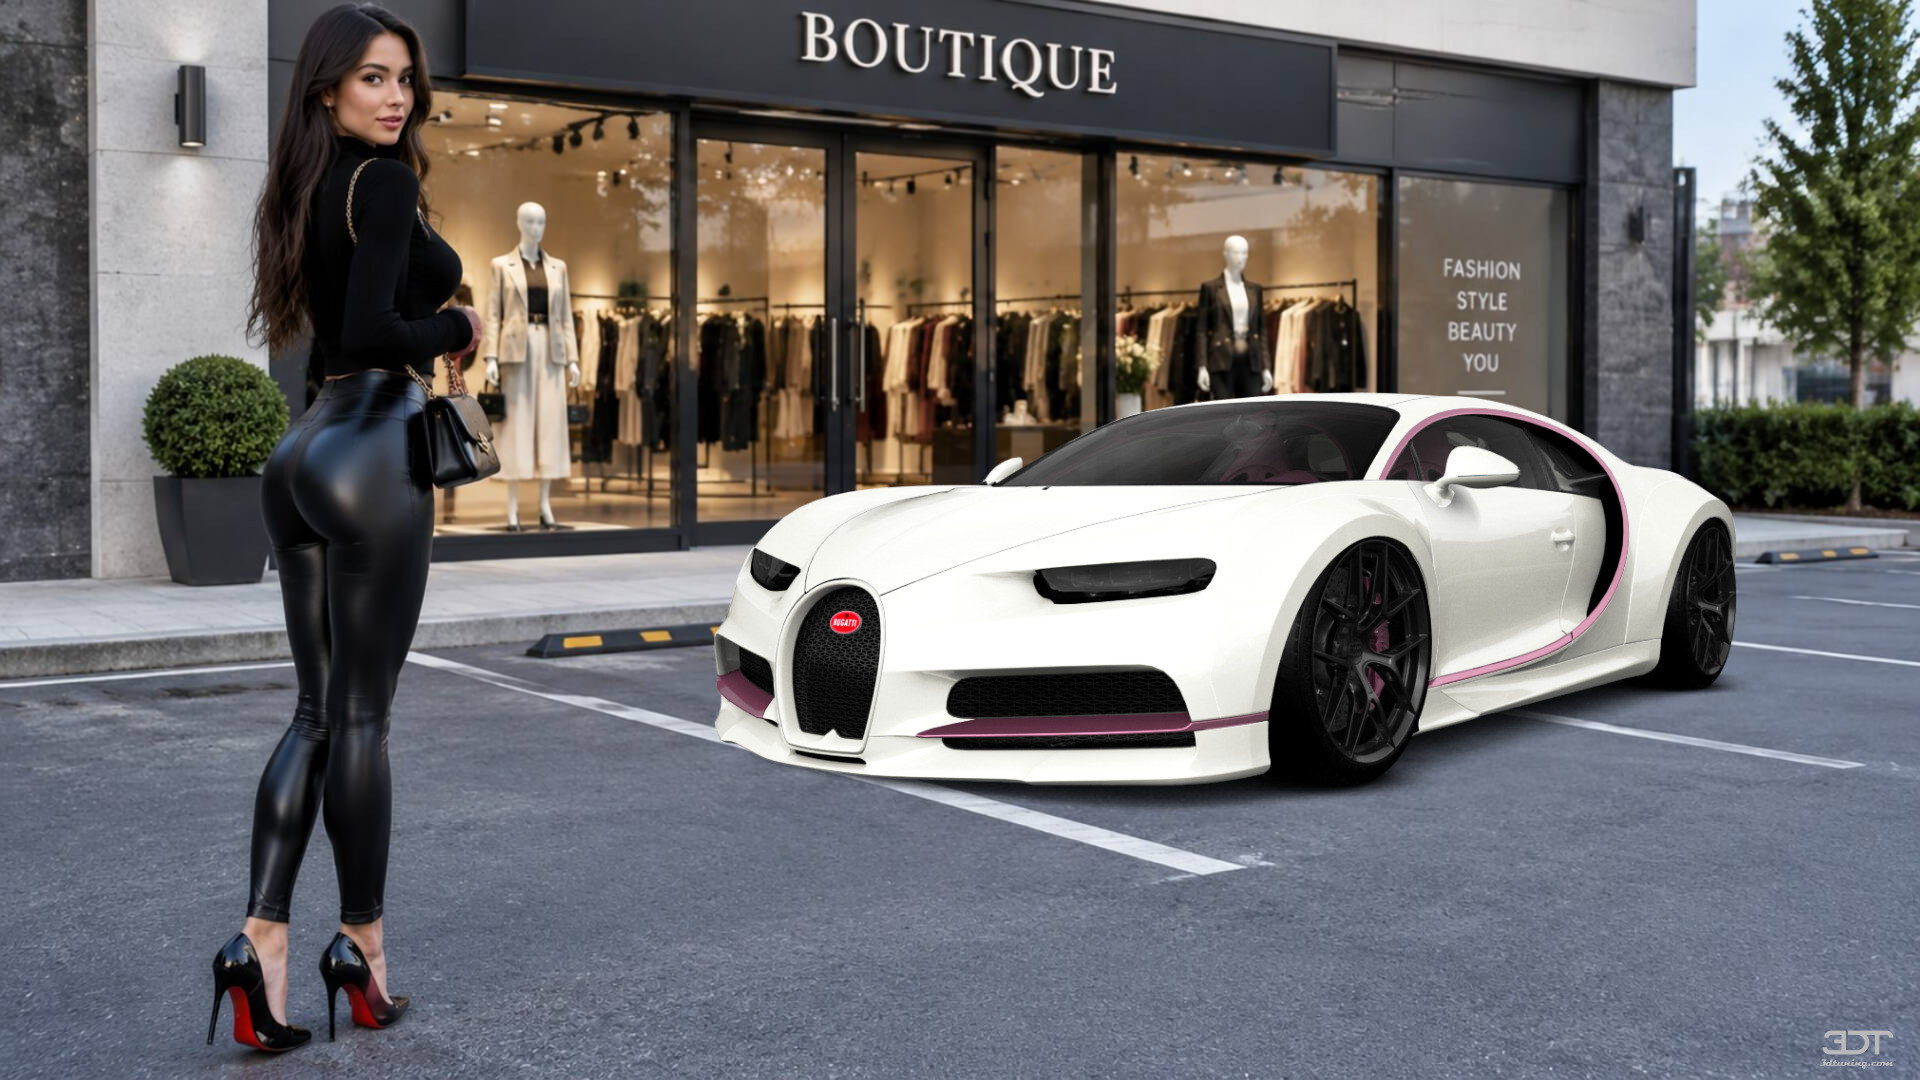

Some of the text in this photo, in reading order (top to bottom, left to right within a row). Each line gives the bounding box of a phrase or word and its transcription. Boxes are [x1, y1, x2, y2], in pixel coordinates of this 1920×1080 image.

[801, 11, 1117, 98] BOUTIQUE
[1443, 257, 1521, 280] FASHION
[1456, 290, 1508, 311] STYLE
[1448, 321, 1517, 342] BEAUTY
[1463, 352, 1499, 372] YOU
[832, 618, 858, 628] BUGATTI
